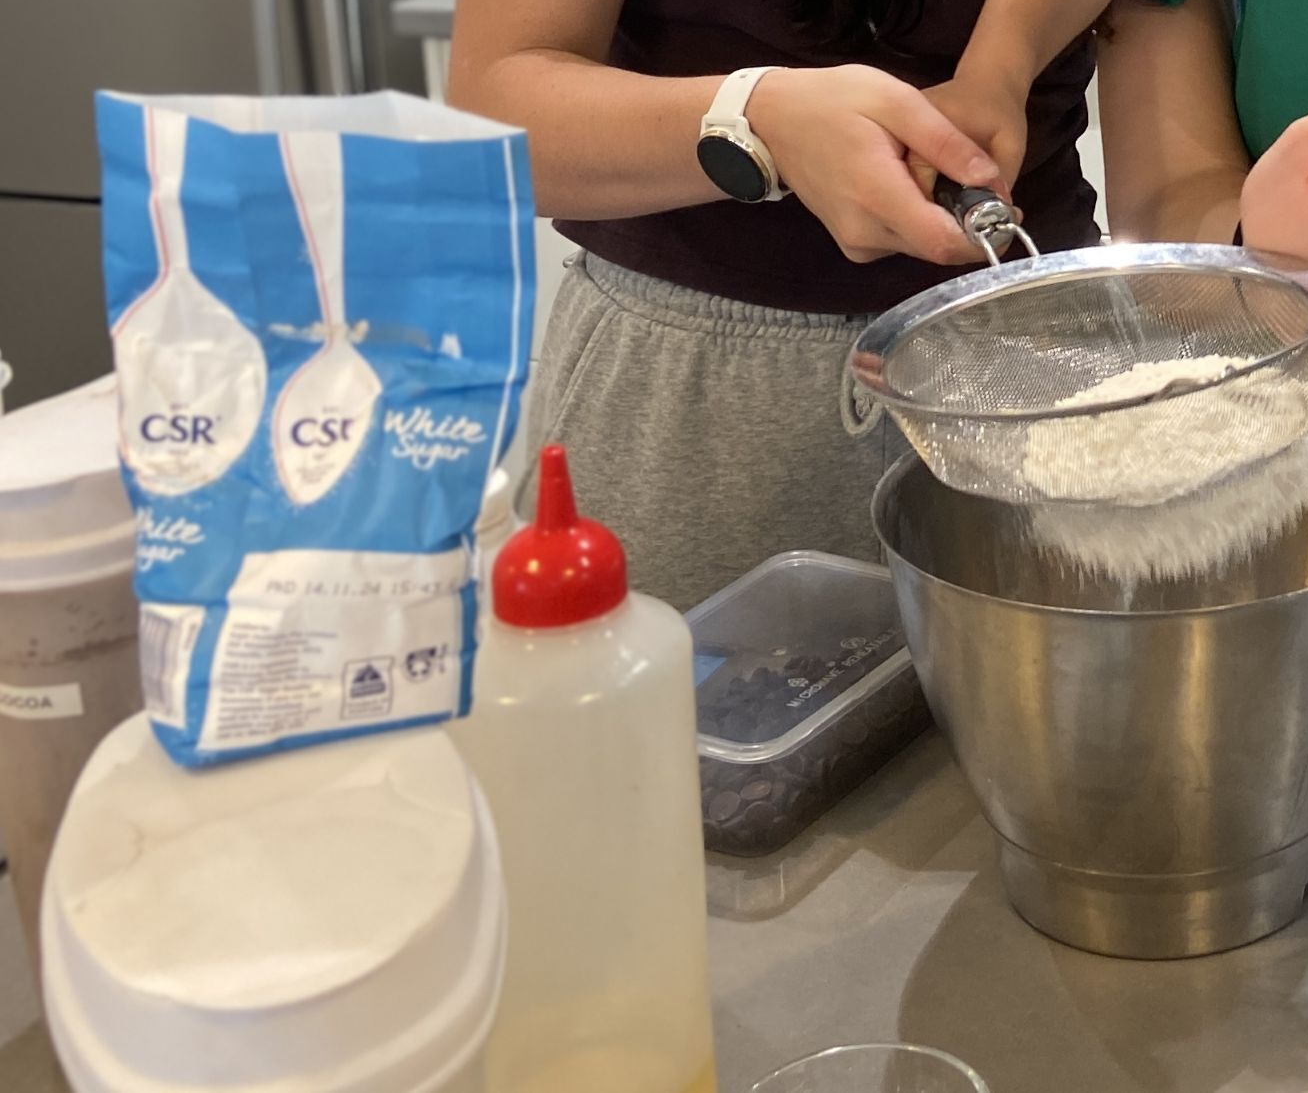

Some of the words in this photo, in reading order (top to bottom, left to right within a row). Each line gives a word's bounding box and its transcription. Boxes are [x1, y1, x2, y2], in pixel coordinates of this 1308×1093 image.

[140, 414, 216, 445] CSR
[384, 406, 486, 443] White
[392, 434, 469, 470] Sugar
[136, 543, 186, 573] ugar
[0, 693, 54, 711] OCOA
